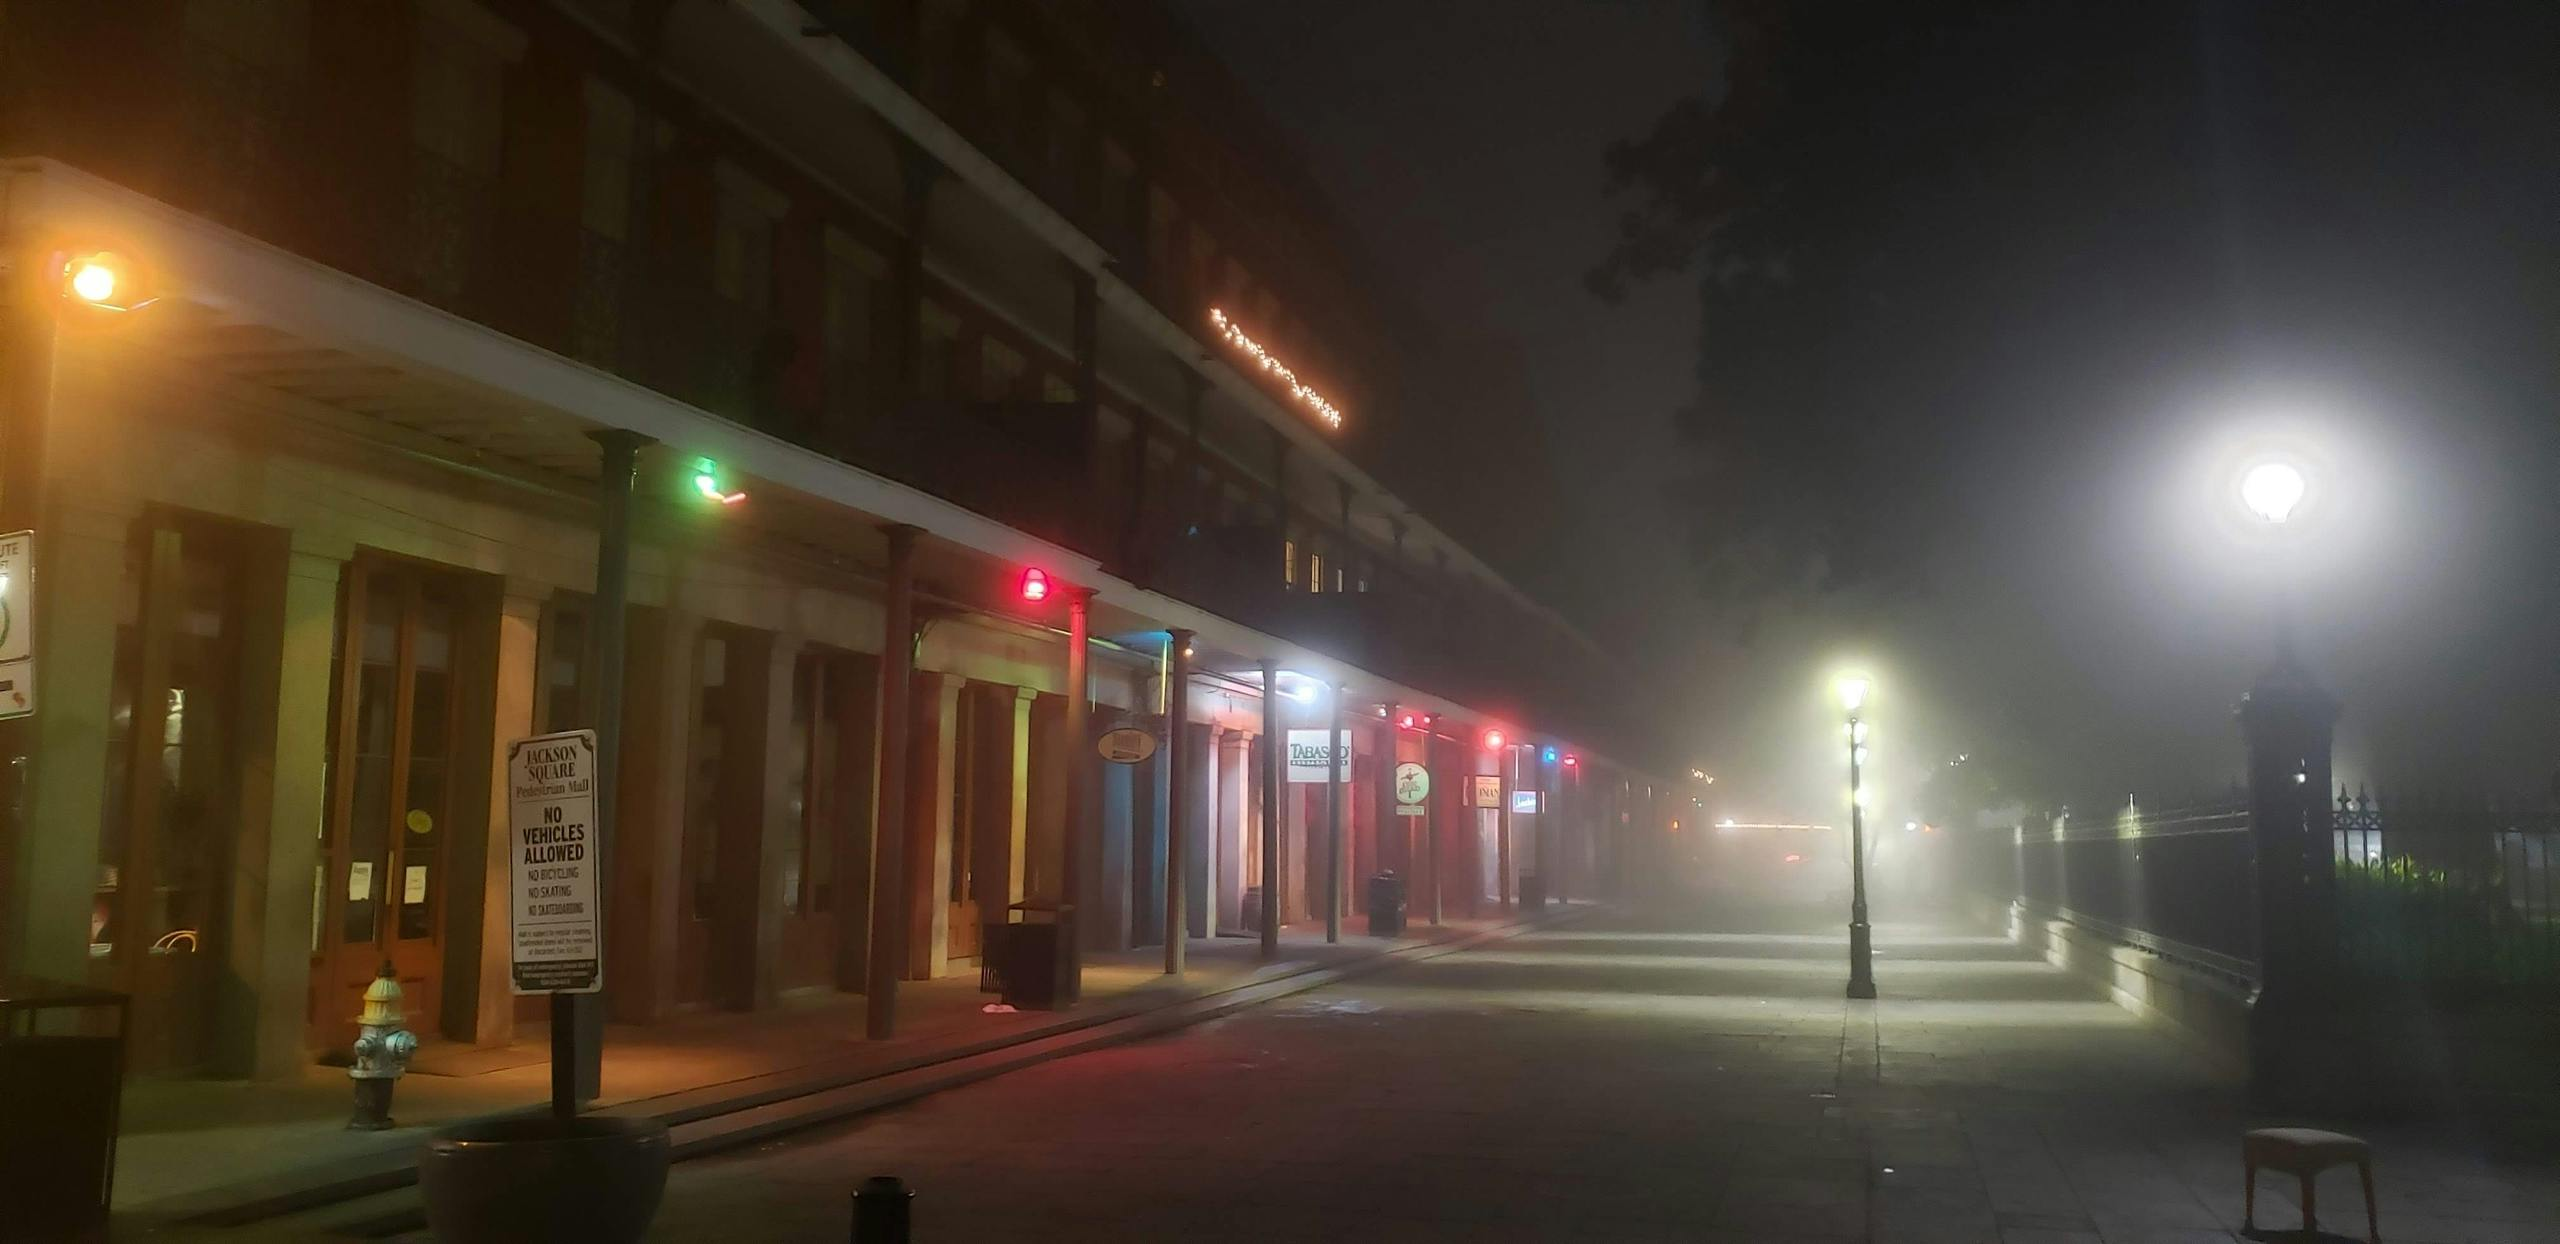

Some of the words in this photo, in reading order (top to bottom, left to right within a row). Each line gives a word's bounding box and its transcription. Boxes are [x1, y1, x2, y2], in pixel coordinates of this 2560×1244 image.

[525, 745, 577, 767] JACKSON
[1290, 743, 1349, 759] TABASO
[529, 762, 576, 784] SQUARE
[516, 782, 565, 798] Pedestrian
[569, 779, 589, 793] Mall
[544, 806, 562, 824] NO
[523, 824, 585, 845] VEHICLES
[524, 843, 584, 865] ALLOWED
[528, 869, 539, 881] NO
[541, 867, 579, 880] BICYCLING
[528, 887, 539, 899] NO
[541, 885, 572, 898] SKATING
[528, 904, 537, 916] NO
[538, 902, 584, 916] SKATEBOARDING
